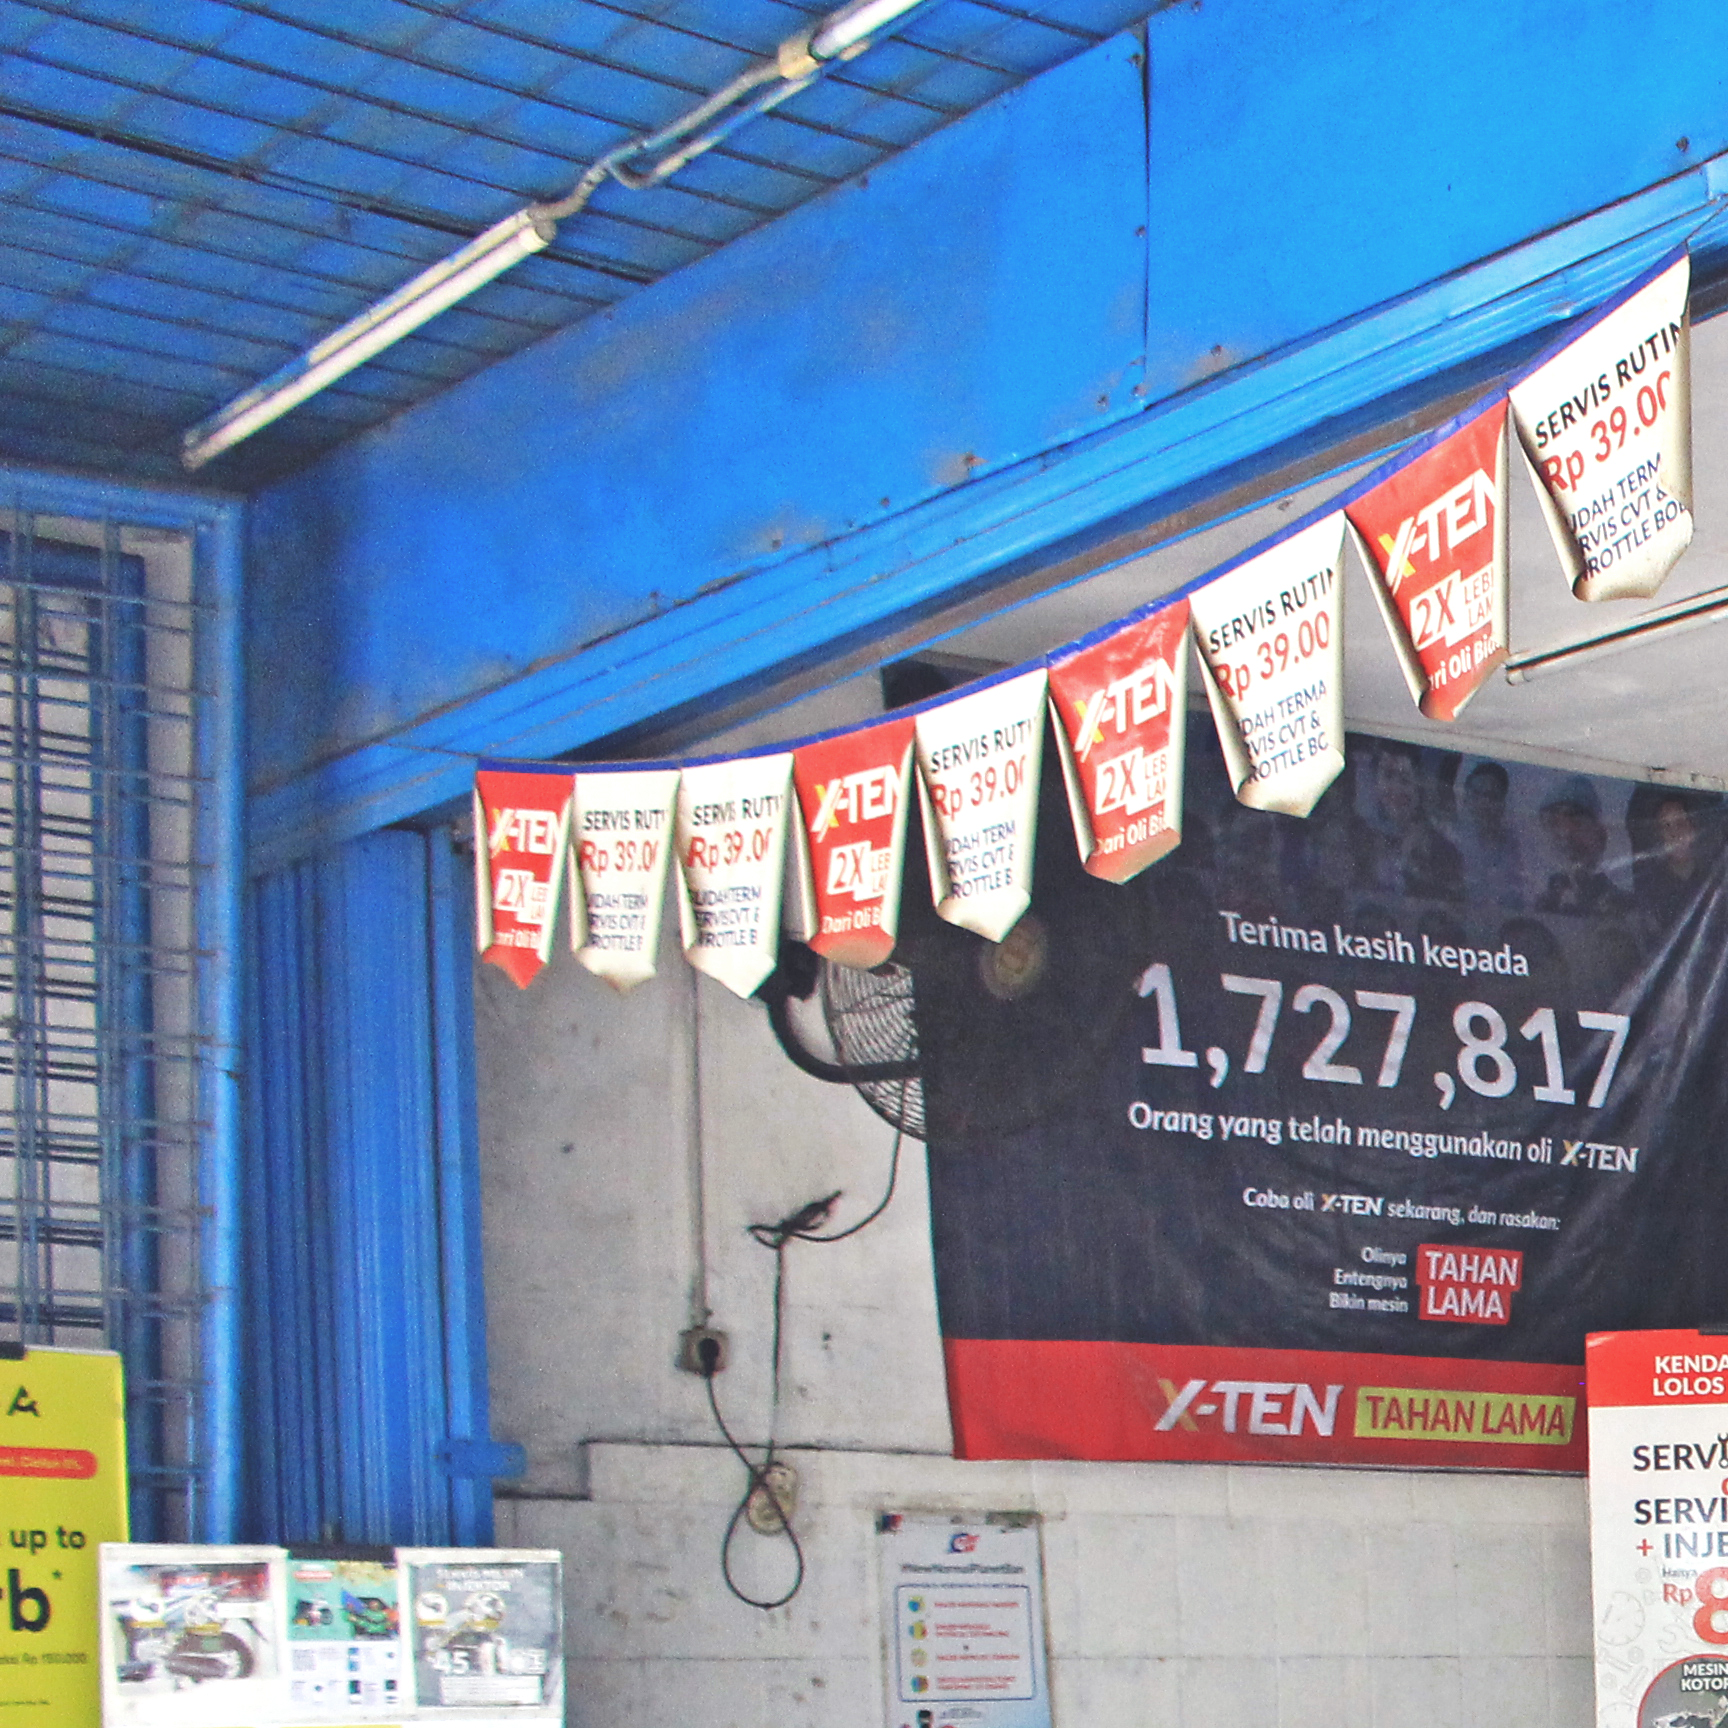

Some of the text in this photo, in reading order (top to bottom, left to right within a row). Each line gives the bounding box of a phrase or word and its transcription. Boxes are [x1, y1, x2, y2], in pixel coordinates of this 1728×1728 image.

[1535, 373, 1611, 448] SERVIS
[1542, 450, 1585, 492] Rp
[1621, 490, 1651, 527] CVT
[1377, 468, 1496, 596] X-TEN
[1209, 600, 1276, 654] SERVIS
[1416, 579, 1455, 646] 2X
[1450, 646, 1471, 678] Oli
[1213, 663, 1250, 701] Rp
[1074, 658, 1175, 763] X-TEN
[1279, 710, 1320, 745] CVT &
[931, 734, 989, 774] SERVIS
[1102, 755, 1138, 809] 2X
[583, 810, 630, 831] SERVIS
[810, 765, 901, 843] X-TEN
[931, 783, 962, 821] Rp
[1127, 816, 1147, 845] Oli
[580, 840, 608, 878] Rp
[687, 836, 719, 873] Rp
[833, 847, 866, 890] 2X
[499, 875, 529, 907] 2X
[1220, 910, 1529, 978] Terima kasih kepada
[1133, 963, 1631, 1111] 1,727,817
[1128, 1101, 1639, 1174] Orang yang telah menggunakan oli X-TEN
[1242, 1187, 1290, 1210] Coba
[1293, 1192, 1314, 1211] oli
[1321, 1193, 1385, 1217] X-TEN
[1468, 1205, 1496, 1225] dan
[1361, 1247, 1407, 1266] Olinya
[1425, 1250, 1519, 1286] TAHAN
[1329, 1292, 1408, 1313] Bikin mesin
[1428, 1285, 1505, 1318] LAMA
[1653, 1376, 1724, 1396] LOLOS
[1154, 1379, 1566, 1437] X-TEN TAHAN LAMA
[9, 1525, 86, 1553] up to
[1663, 1583, 1693, 1606] Rp
